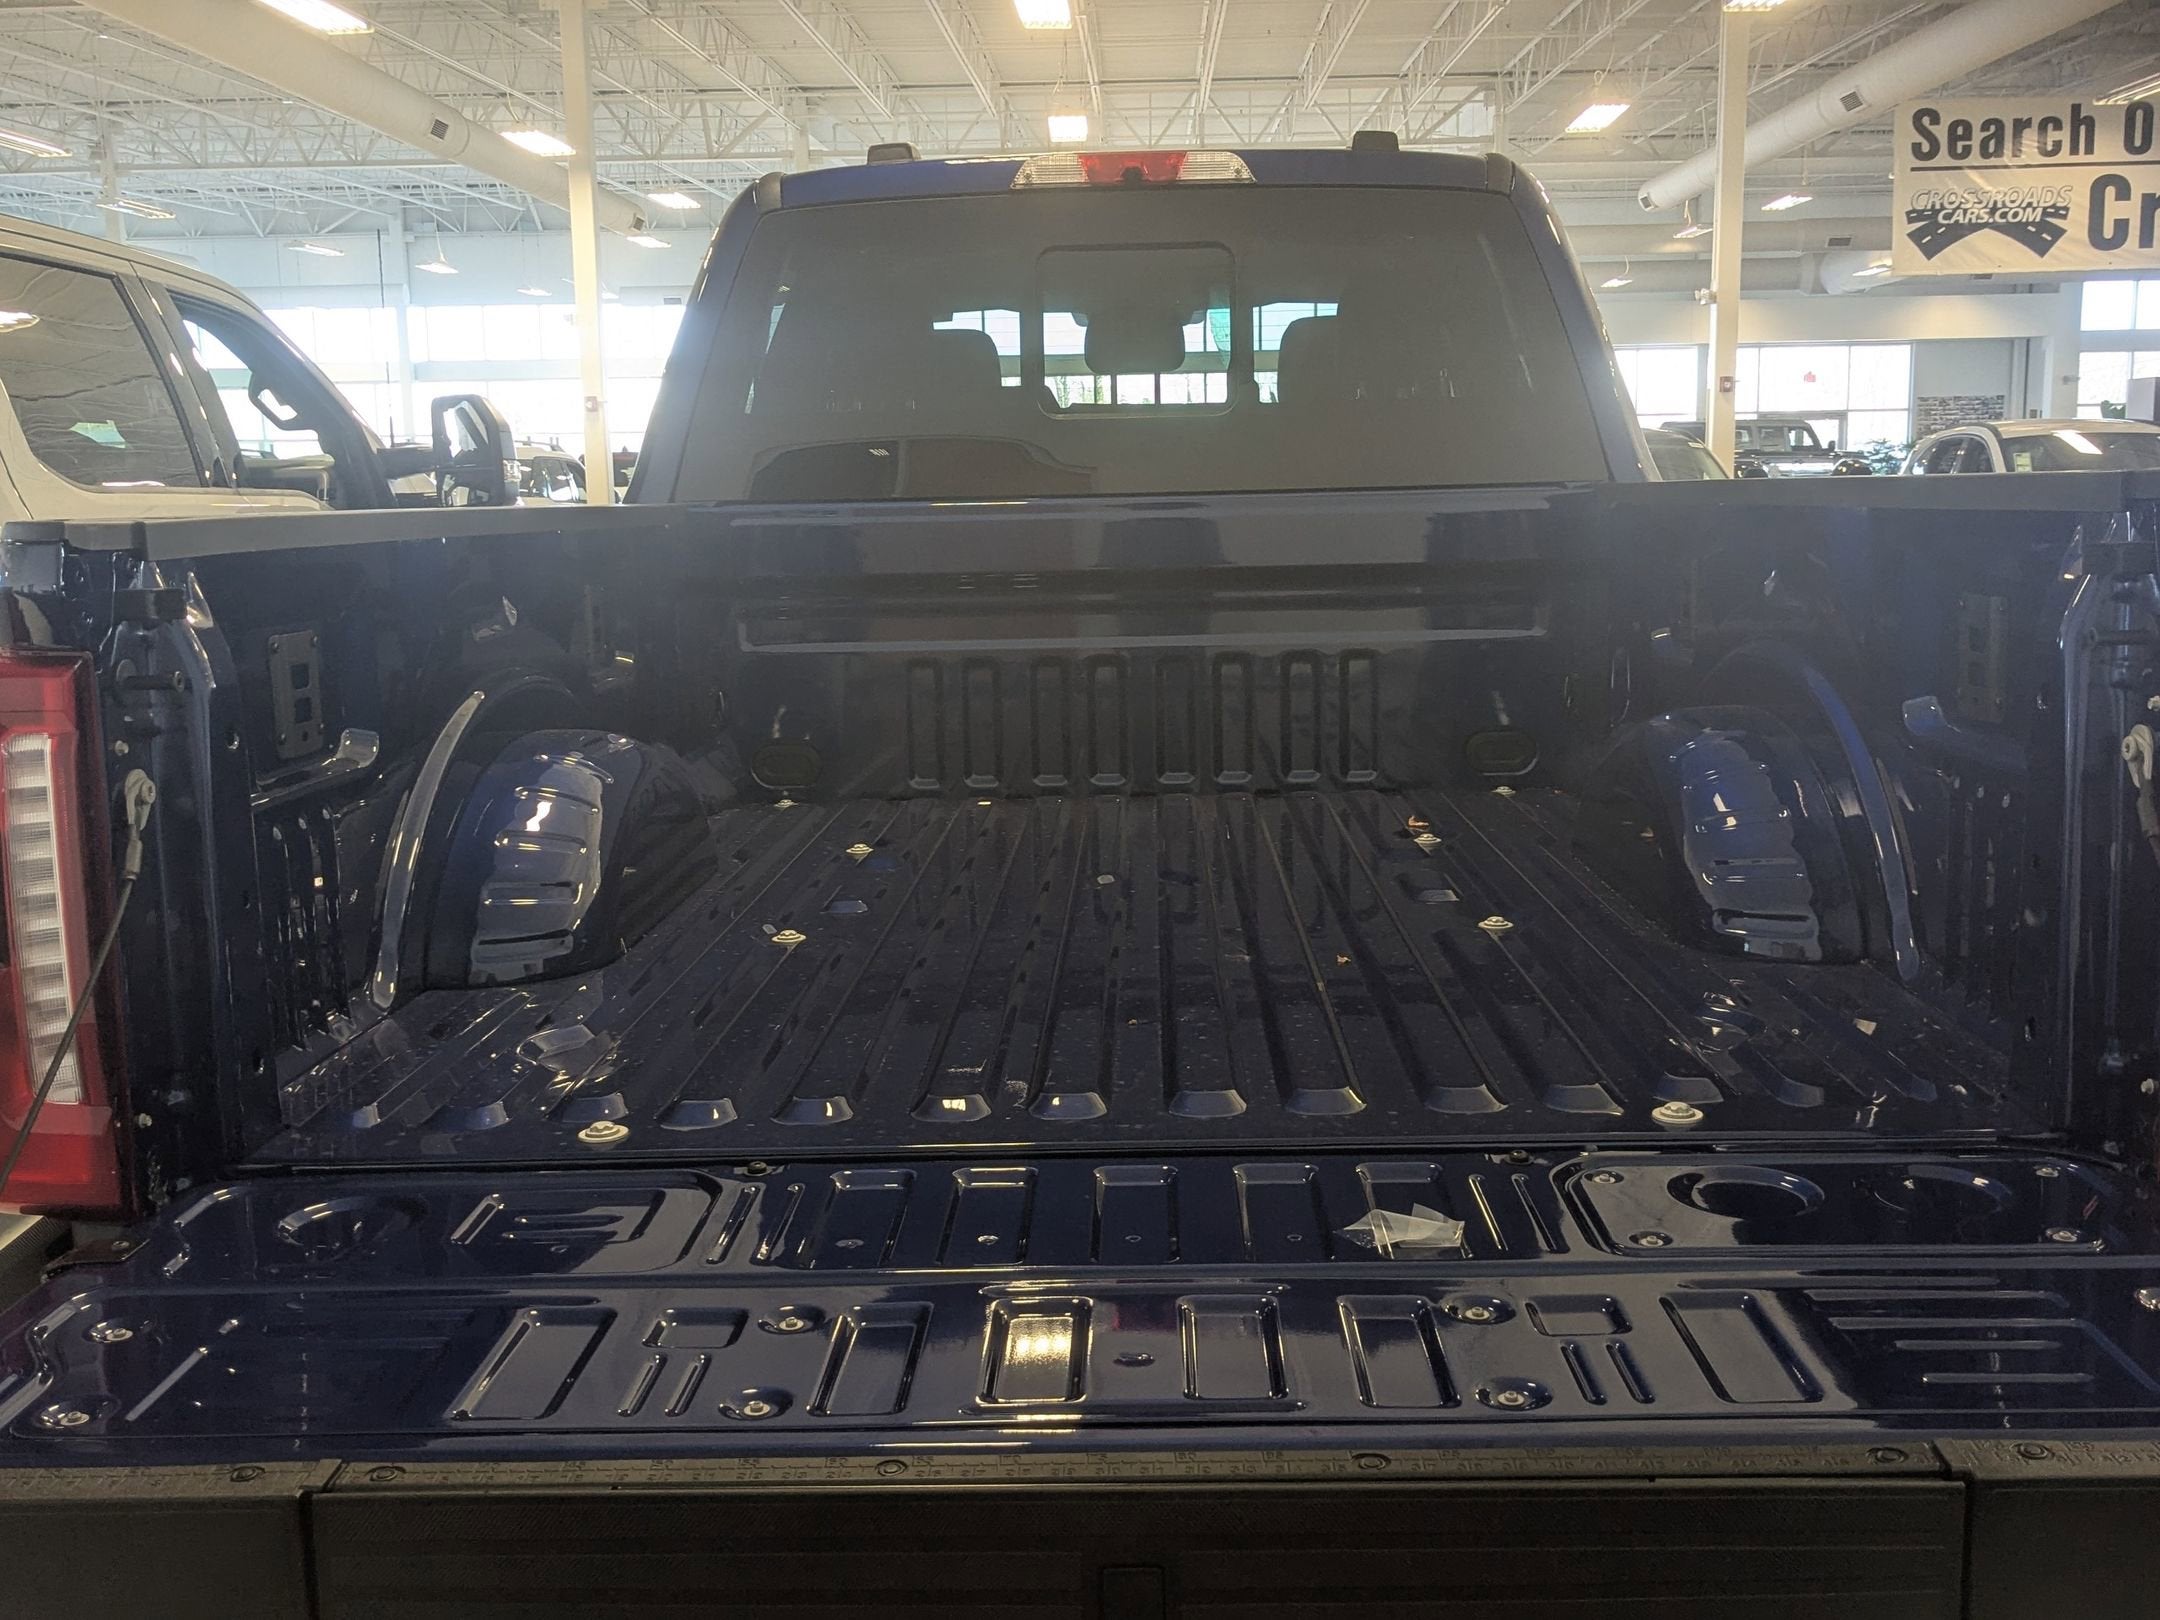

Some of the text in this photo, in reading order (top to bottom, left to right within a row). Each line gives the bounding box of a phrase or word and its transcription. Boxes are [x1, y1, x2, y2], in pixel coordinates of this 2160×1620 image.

[1911, 103, 2095, 161] Search
[1910, 185, 2073, 210] CROSSROADS
[1937, 207, 2043, 224] CARS.COM
